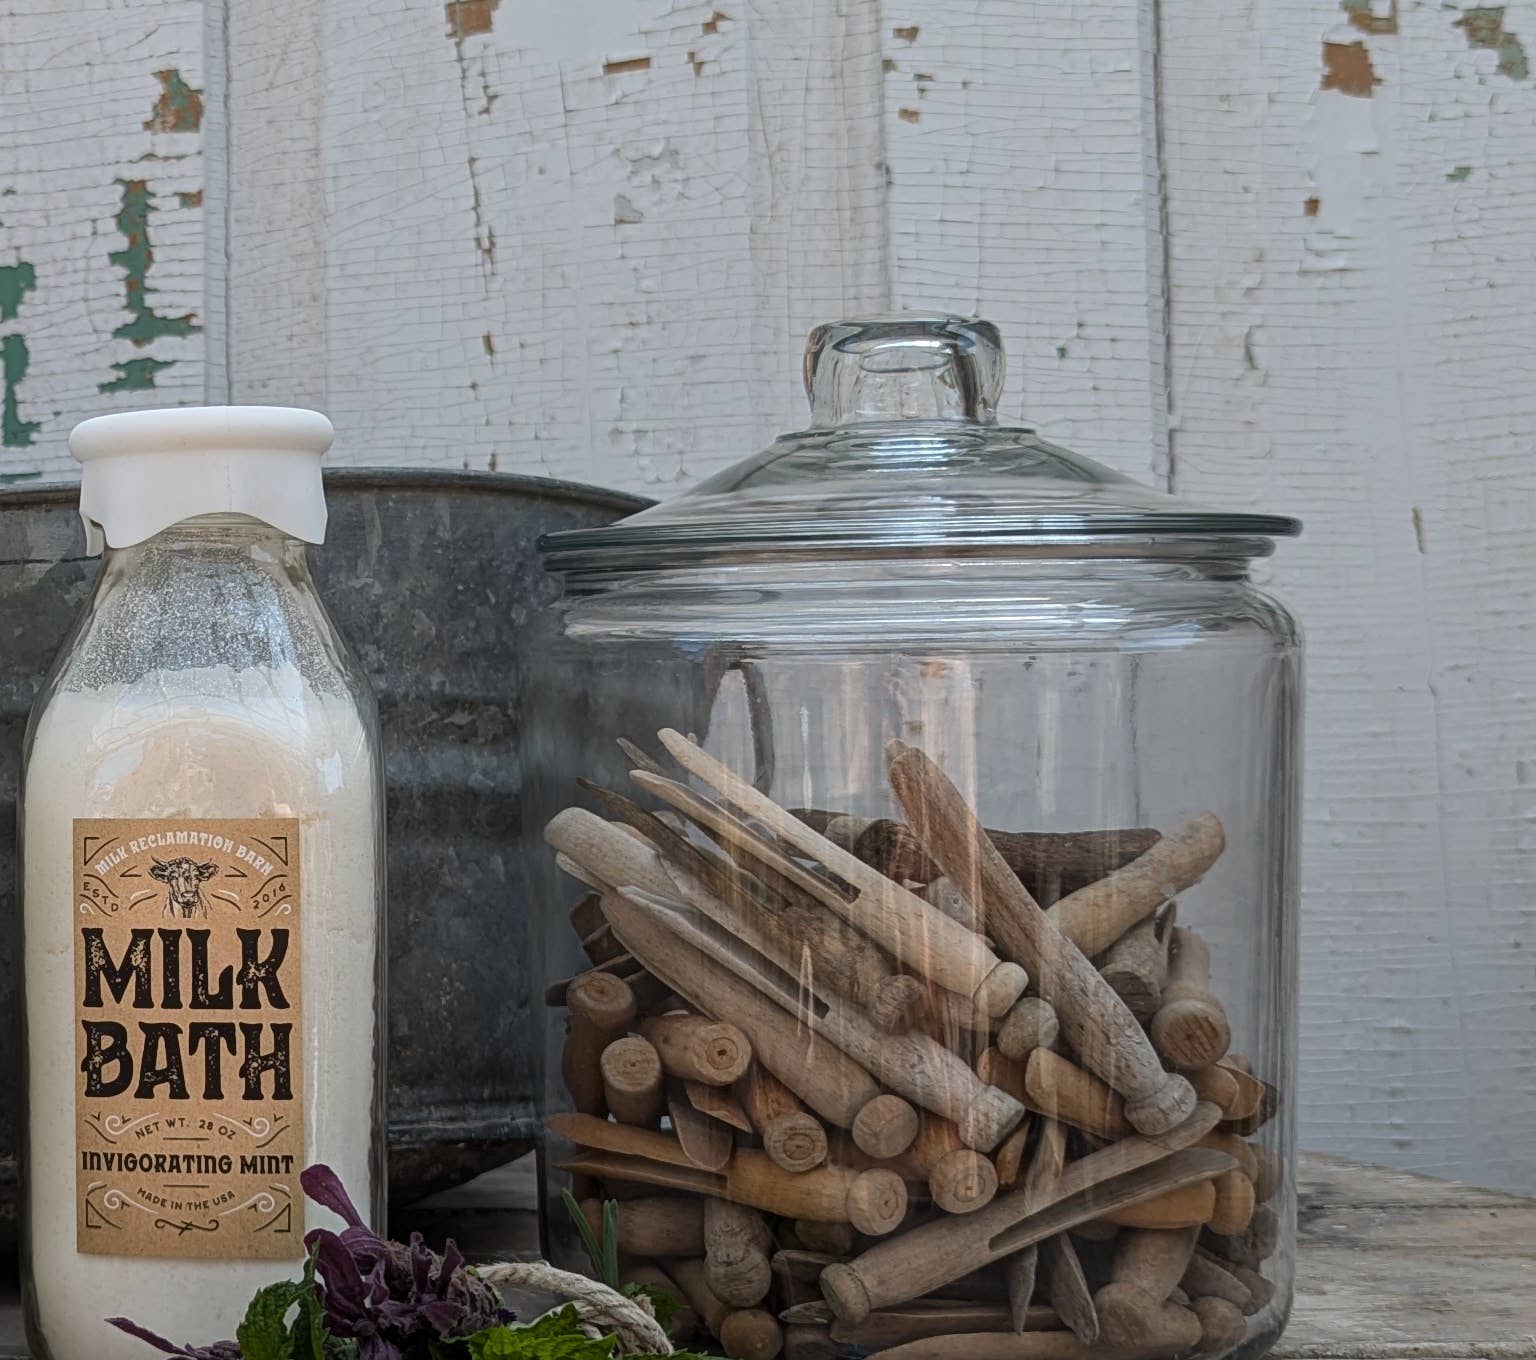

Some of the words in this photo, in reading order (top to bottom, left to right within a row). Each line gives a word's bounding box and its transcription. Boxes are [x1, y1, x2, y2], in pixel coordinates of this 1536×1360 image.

[95, 845, 128, 876] MILK
[129, 831, 233, 854] RECLAMATION
[236, 845, 275, 876] BARN
[84, 882, 119, 912] ESTD
[253, 882, 285, 909] 2016
[81, 928, 290, 1010] MILK
[81, 1020, 293, 1100] BATH
[135, 1121, 160, 1139] NET
[166, 1118, 189, 1128] WT.
[199, 1119, 212, 1130] 28
[218, 1126, 236, 1140] OZ
[82, 1151, 232, 1174] INVIGORATING
[240, 1155, 293, 1174] MINT
[137, 1188, 166, 1208] MADE
[171, 1201, 182, 1210] IN
[187, 1200, 210, 1211] THE
[213, 1191, 235, 1205] USA
